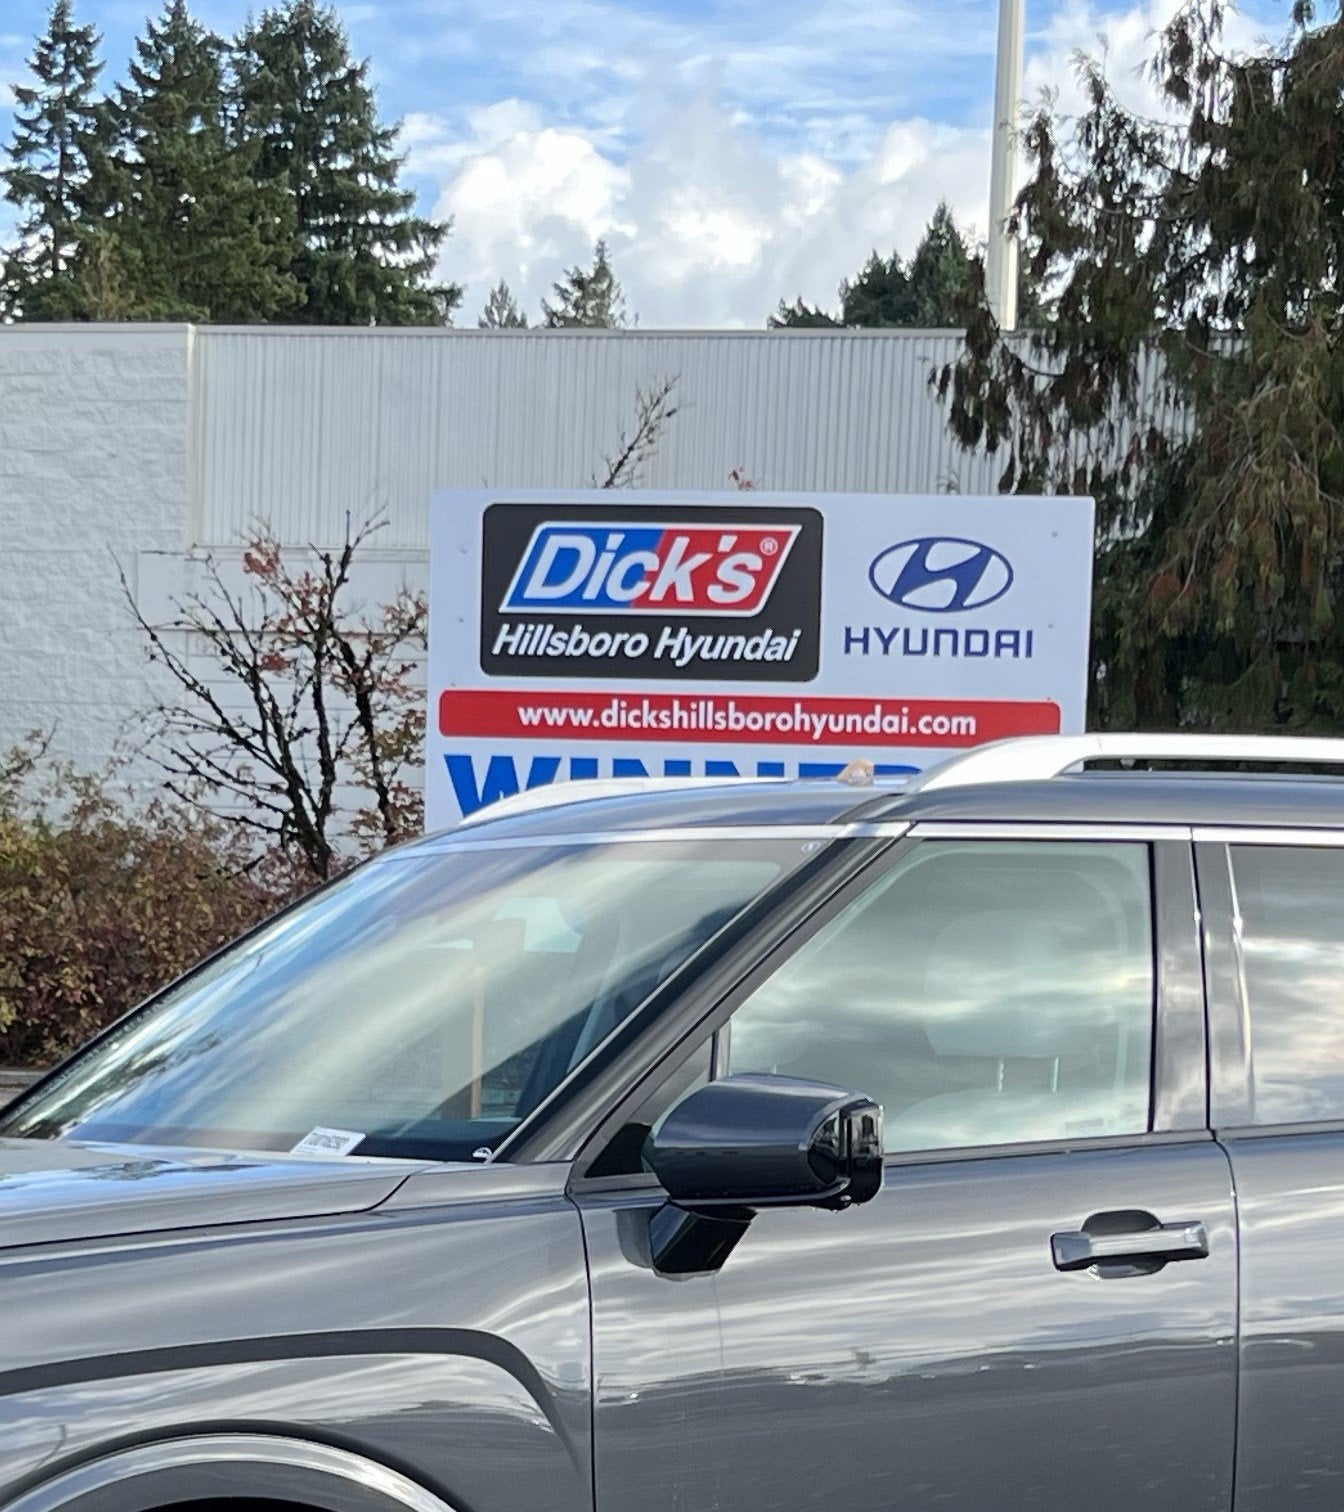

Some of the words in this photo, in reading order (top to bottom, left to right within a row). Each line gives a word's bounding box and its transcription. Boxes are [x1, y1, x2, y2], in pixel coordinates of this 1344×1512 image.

[522, 532, 763, 605] Dick's
[492, 623, 650, 658] Hillsboro
[653, 626, 803, 668] Hyundai
[843, 626, 1035, 660] HYUNDAI
[517, 698, 978, 741] www.dickshillsborohyundai.com
